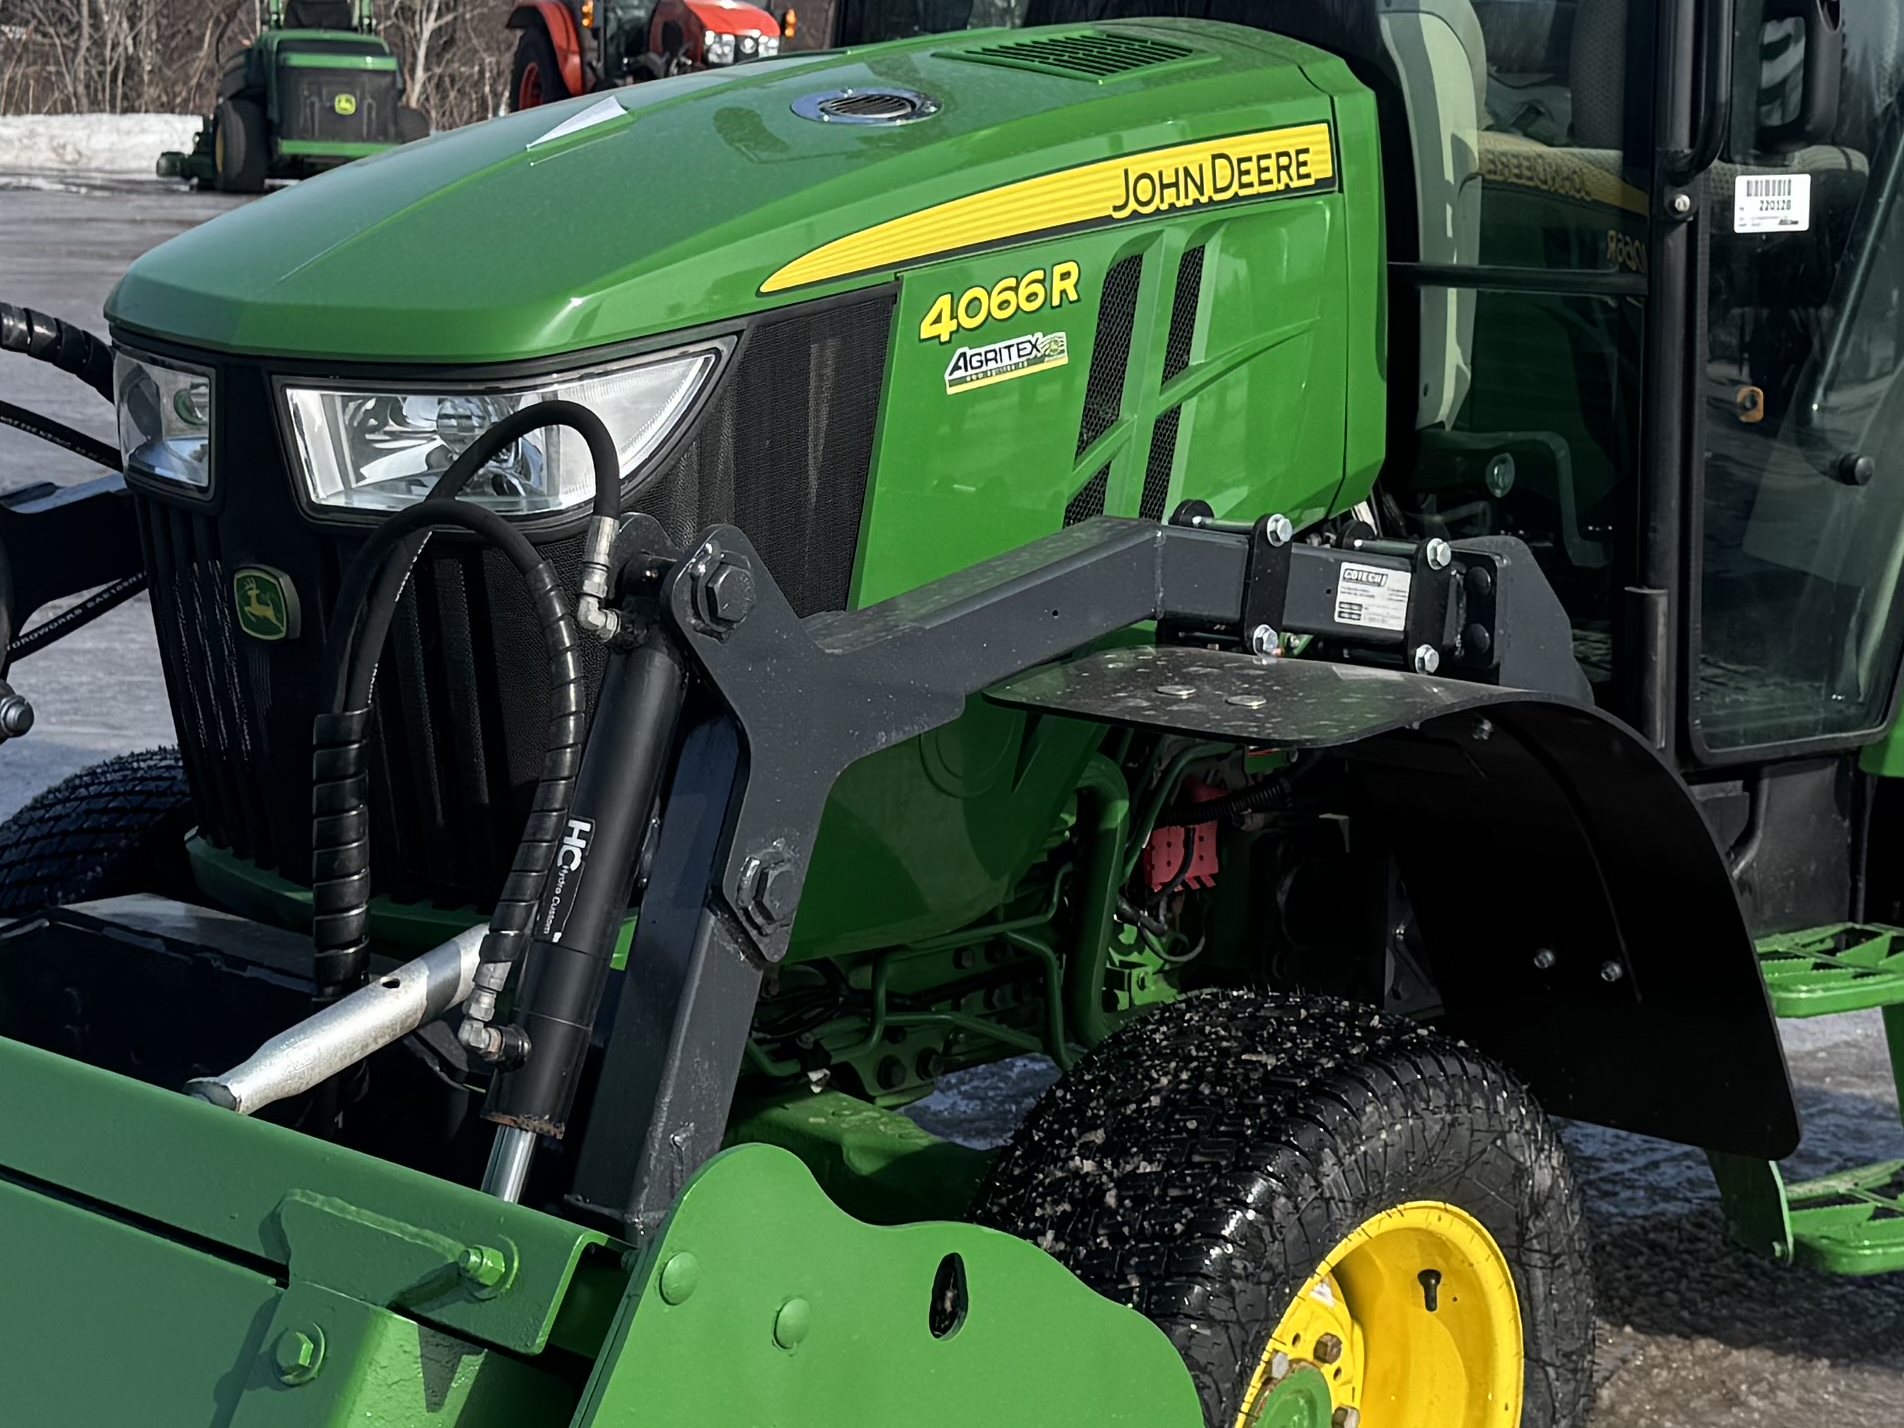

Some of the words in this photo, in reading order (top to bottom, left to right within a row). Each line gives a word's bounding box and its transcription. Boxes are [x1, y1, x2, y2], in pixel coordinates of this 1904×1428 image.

[1112, 163, 1205, 213] JOHN
[1210, 147, 1312, 195] DEERE
[919, 260, 1081, 345] 4066R
[948, 337, 1042, 377] AGRITEX
[557, 819, 591, 871] HC
[555, 865, 568, 895] Hydro
[543, 896, 561, 934] Custom
